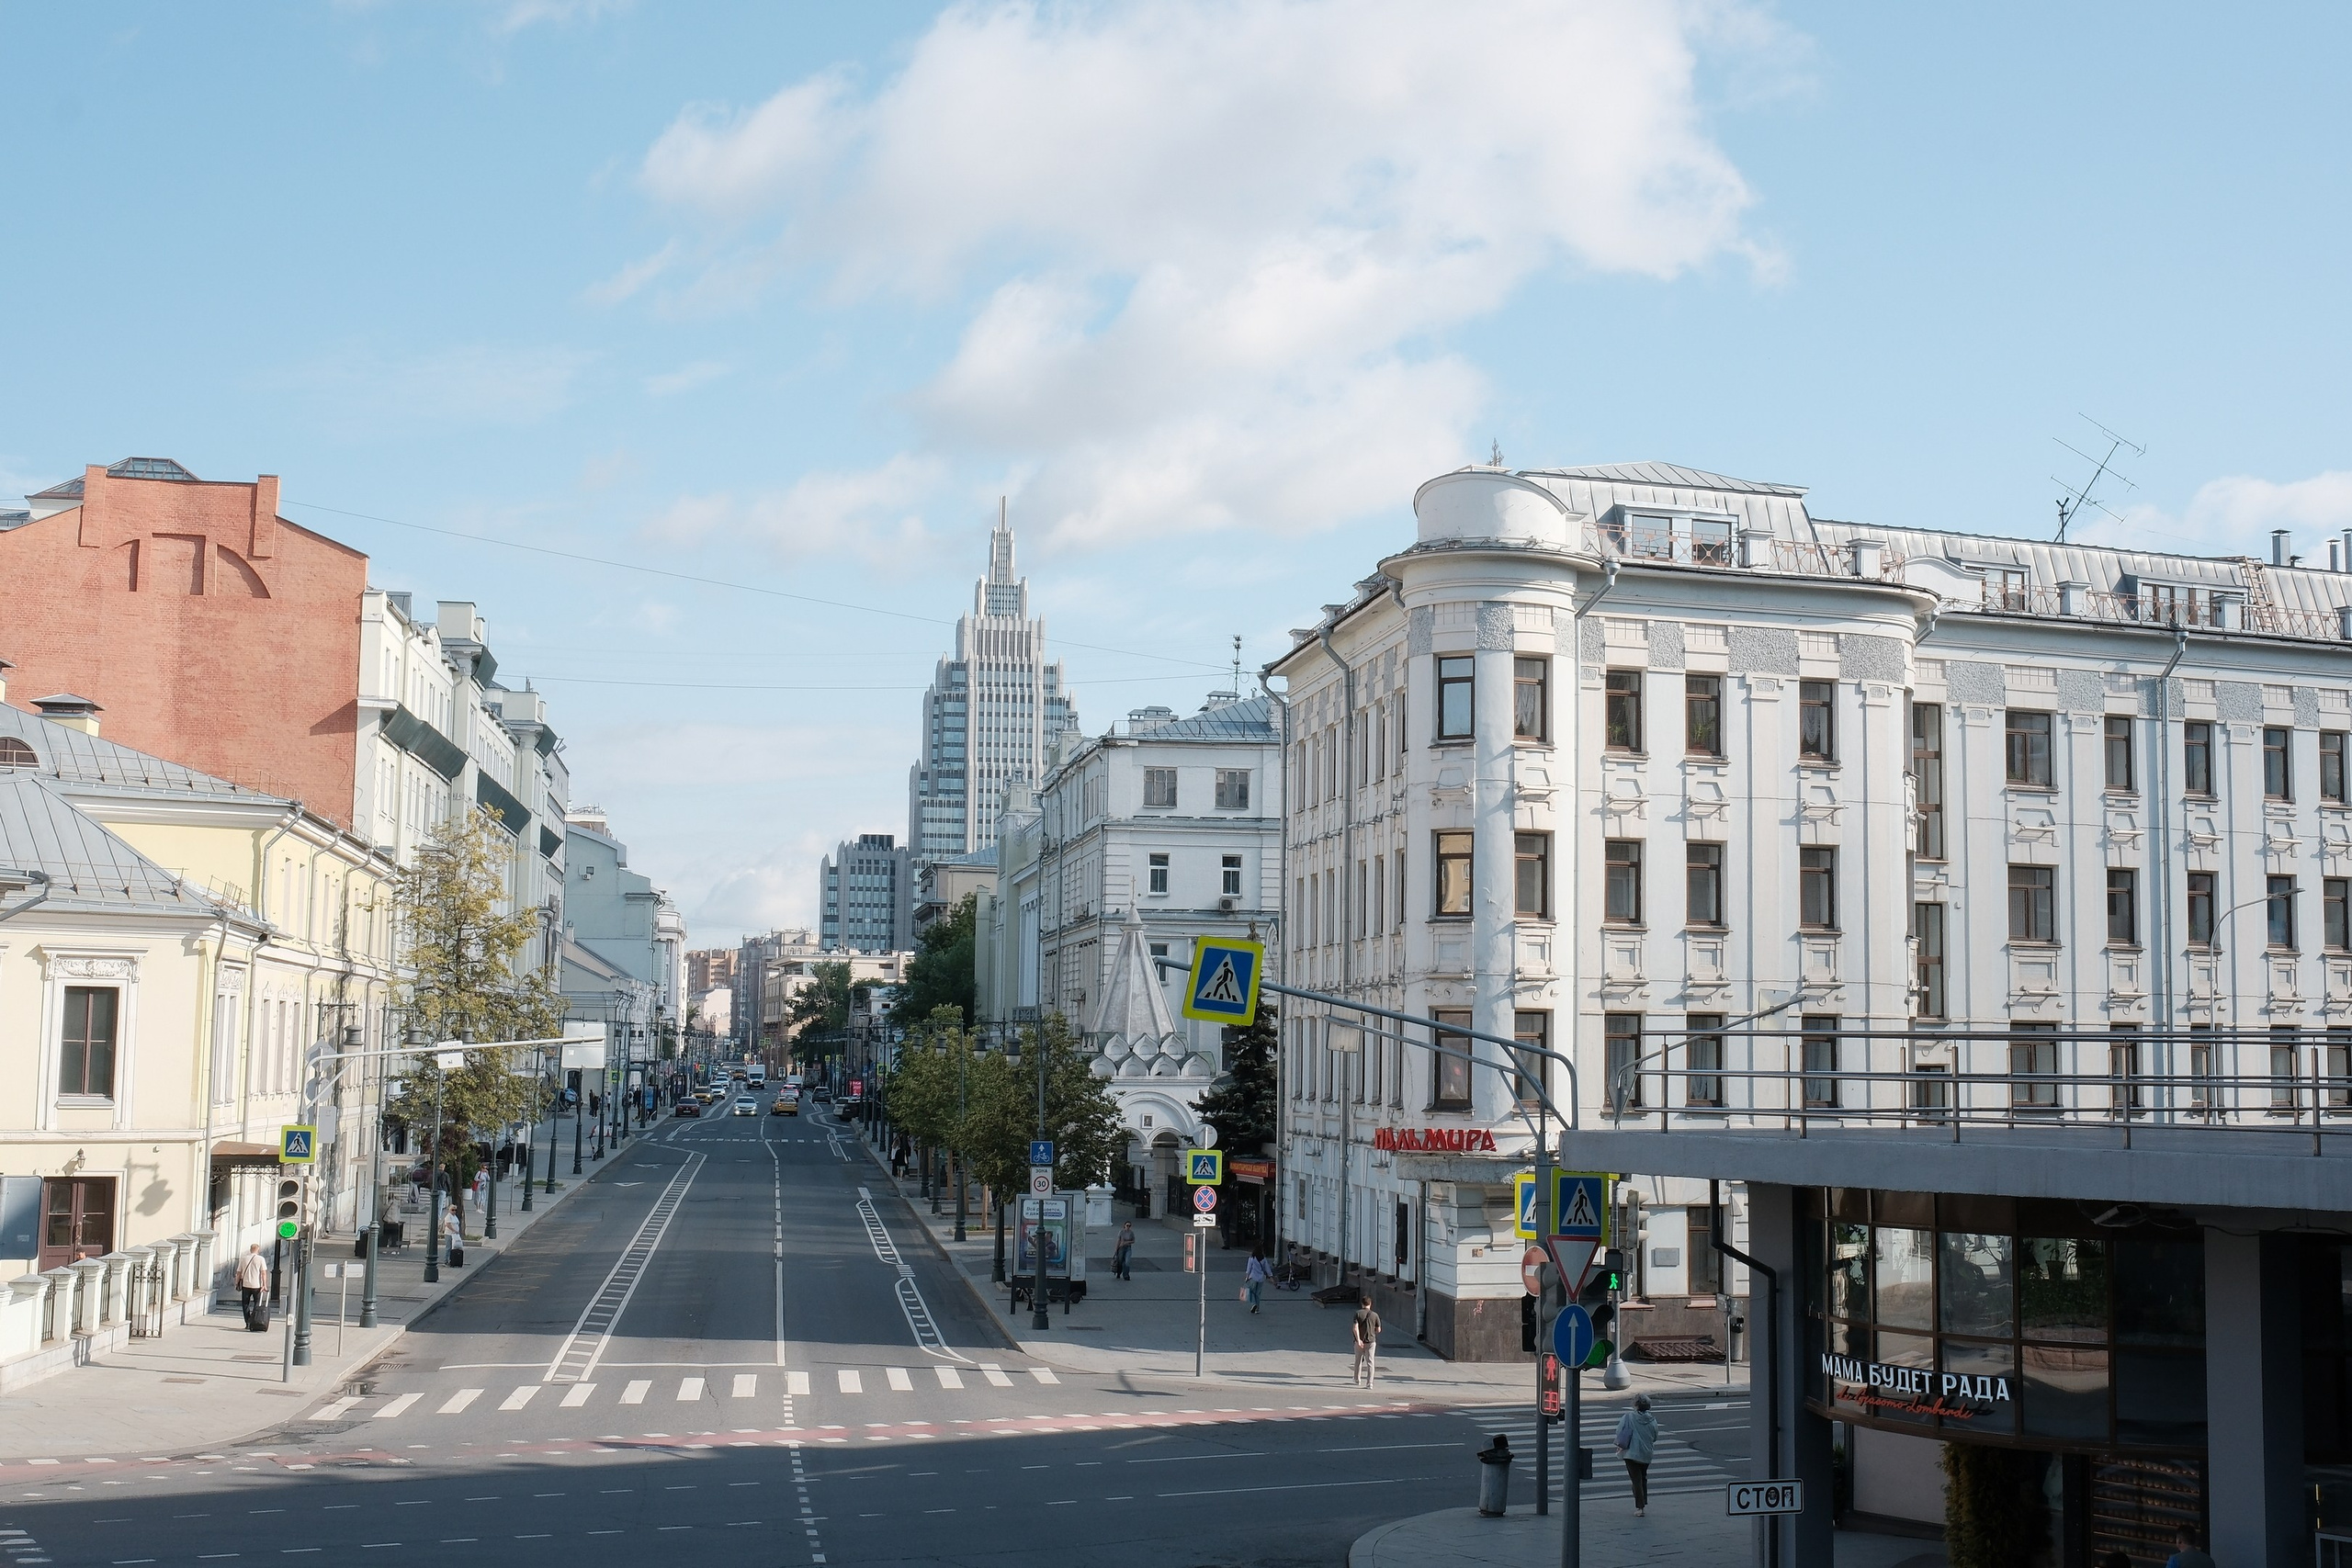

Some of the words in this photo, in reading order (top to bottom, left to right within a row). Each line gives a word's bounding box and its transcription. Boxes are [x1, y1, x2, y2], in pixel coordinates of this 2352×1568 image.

[1374, 1127, 1497, 1152] ПАЛЬМИРА
[1823, 1353, 1863, 1383] МАМА
[1869, 1364, 1932, 1394] БУДЕТ
[1942, 1373, 2010, 1404] РАДА
[1905, 1395, 1974, 1419] Lombardi
[1736, 1486, 1794, 1509] СТОП
